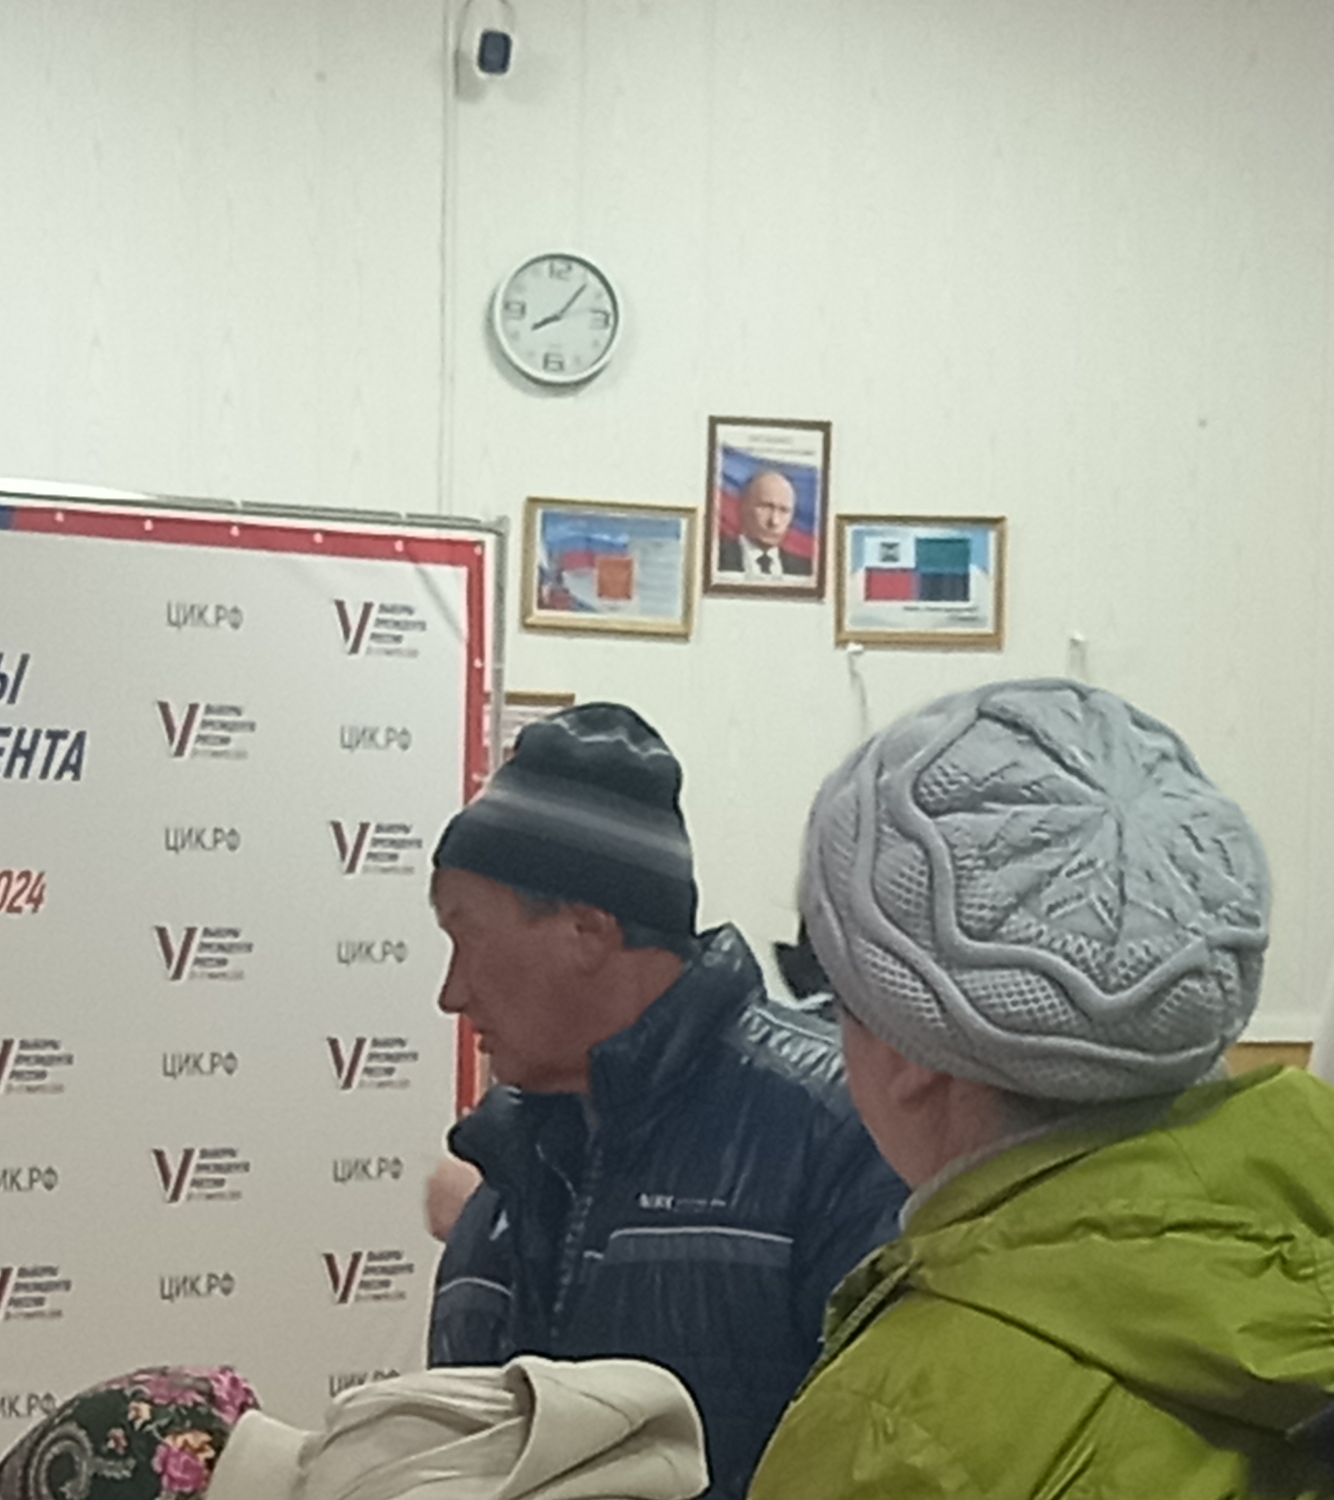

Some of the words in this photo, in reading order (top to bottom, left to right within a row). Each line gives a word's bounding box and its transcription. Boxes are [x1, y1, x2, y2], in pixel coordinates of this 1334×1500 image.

[167, 602, 243, 630] ЦИК.РФ
[165, 827, 240, 854] ЦИК.РФ
[163, 1052, 237, 1079] ЦИК.РФ
[160, 1273, 234, 1302] ЦИК.РФ
